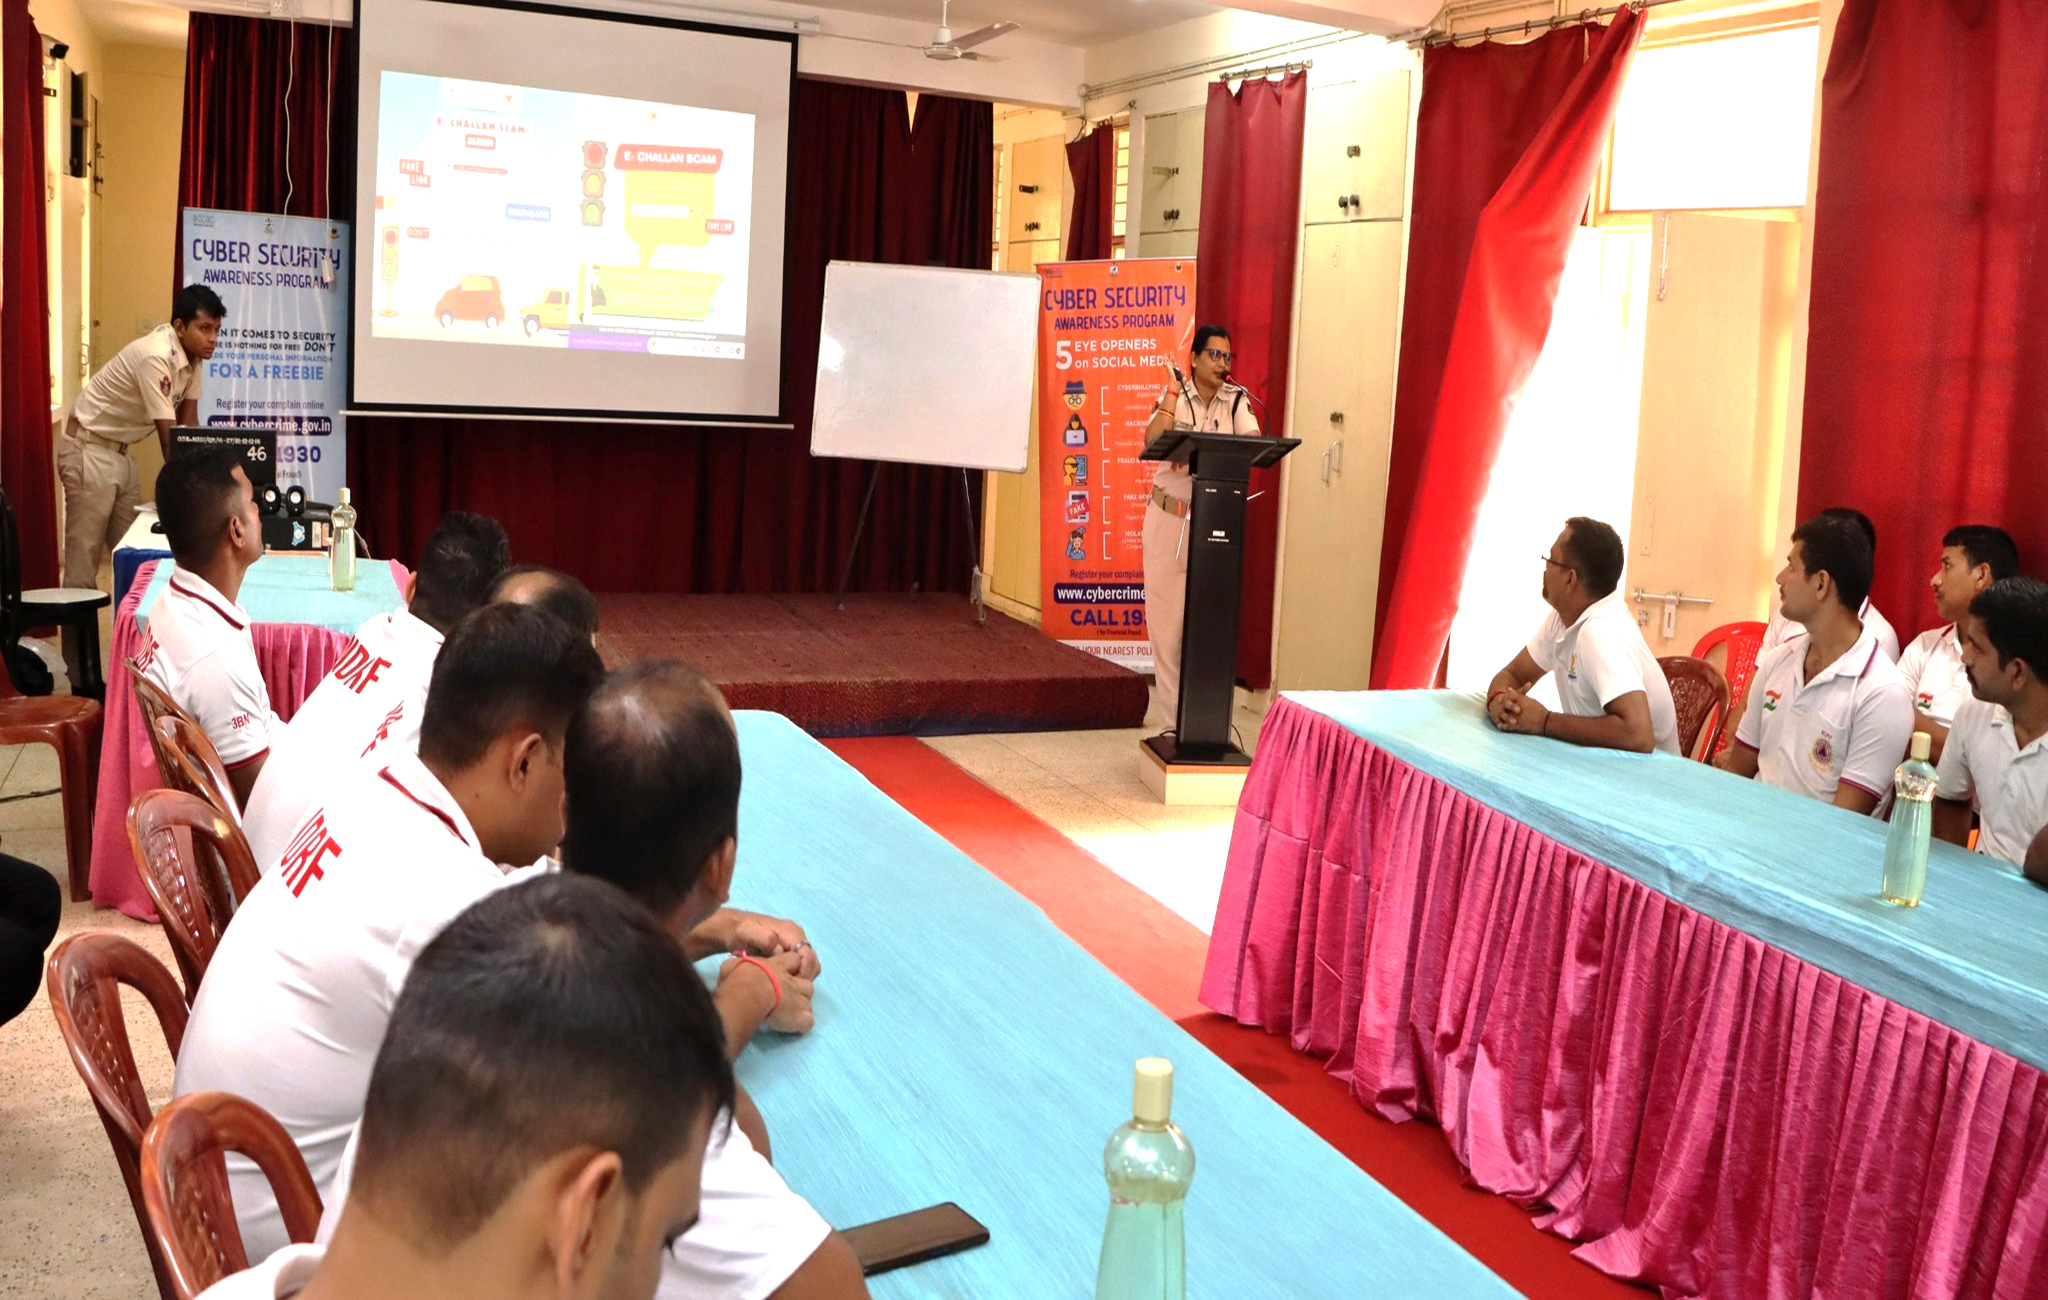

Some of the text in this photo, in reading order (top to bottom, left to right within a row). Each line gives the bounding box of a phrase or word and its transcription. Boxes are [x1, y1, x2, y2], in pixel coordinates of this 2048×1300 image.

[637, 151, 684, 163] CHALLAN
[686, 153, 717, 164] SCAM
[193, 238, 250, 264] CYBER
[203, 269, 329, 290] AWARENESS PROGRAM
[1044, 285, 1186, 311] CYBER SECURITY
[1054, 313, 1175, 331] AWARENESS PROGRAM
[242, 329, 275, 339] COMES
[278, 331, 290, 340] TO
[292, 331, 336, 341] SECURITY
[1074, 338, 1157, 352] EYE OPENERS
[1055, 340, 1073, 370] 5
[1075, 355, 1165, 369] on SOCIAL MED
[209, 363, 324, 380] FOR A FREEBIE
[248, 401, 265, 411] your
[302, 400, 324, 409] online
[211, 419, 331, 434] wwwcybercrime.gov.in
[246, 446, 267, 461] 46
[276, 445, 322, 463] 1930
[1069, 502, 1086, 516] FAKE
[1070, 569, 1097, 579] Register
[1098, 570, 1113, 580] your
[1057, 586, 1146, 603] www.cybercrime
[1070, 609, 1147, 626] CALL 19
[1103, 646, 1135, 656] NEAREST
[1136, 645, 1153, 656] POLI
[230, 712, 251, 730] 3BN
[280, 806, 343, 899] DRF
